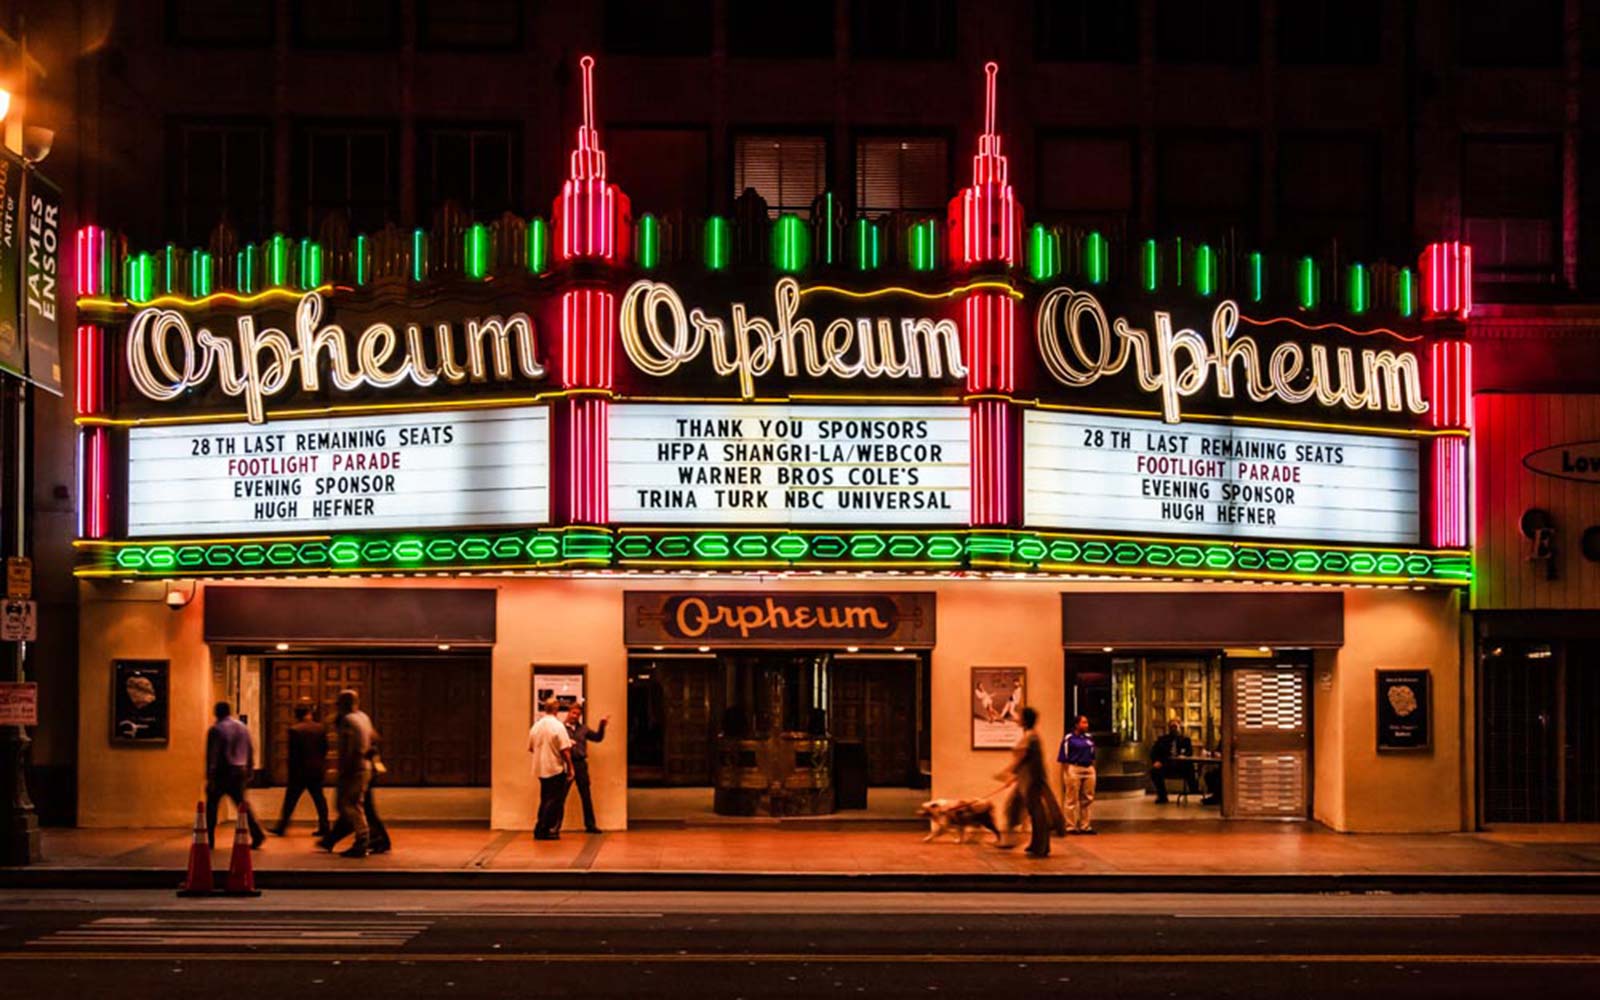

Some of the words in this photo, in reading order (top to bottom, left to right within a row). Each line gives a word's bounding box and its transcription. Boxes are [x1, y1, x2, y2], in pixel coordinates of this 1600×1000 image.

[28, 194, 43, 316] JAMES
[43, 204, 59, 323] ENSOR
[620, 277, 969, 399] Orpheum
[126, 291, 546, 422] Orpheum
[1037, 286, 1430, 424] Orpheum
[244, 434, 286, 454] LAST
[296, 429, 386, 451] REMAINING
[398, 425, 454, 447] SEATS
[676, 418, 744, 438] THANK
[759, 419, 803, 439] YOU
[818, 420, 928, 440] SPONSORS
[657, 442, 709, 462] HFPA
[723, 443, 942, 463] SHANGRI-LA/WEBCOR
[1146, 433, 1189, 454] LAST
[1200, 437, 1287, 461] REMAINING
[1295, 444, 1344, 465] SEATS
[228, 455, 319, 477] FOOTLIGHT
[332, 451, 401, 471] PARADE
[678, 466, 762, 485] WARNER
[777, 466, 834, 486] BROS
[848, 466, 919, 486] COLE'S
[1137, 455, 1227, 479] FOOTLIGHT
[1238, 462, 1301, 483] PARADE
[234, 478, 302, 498] EVENING
[315, 474, 395, 495] SPONSOR
[637, 489, 698, 508] TRINA
[714, 489, 768, 509] TURK
[784, 490, 824, 510] NBC
[838, 490, 952, 510] UNIVERSAL
[1142, 478, 1210, 500] EVENING
[1221, 483, 1295, 505] SPONSOR
[254, 501, 298, 520] HUGH
[312, 498, 375, 518] HEFNER
[1161, 502, 1205, 522] HUGH
[1216, 505, 1277, 526] HEFNER
[676, 597, 888, 637] Orpheum
